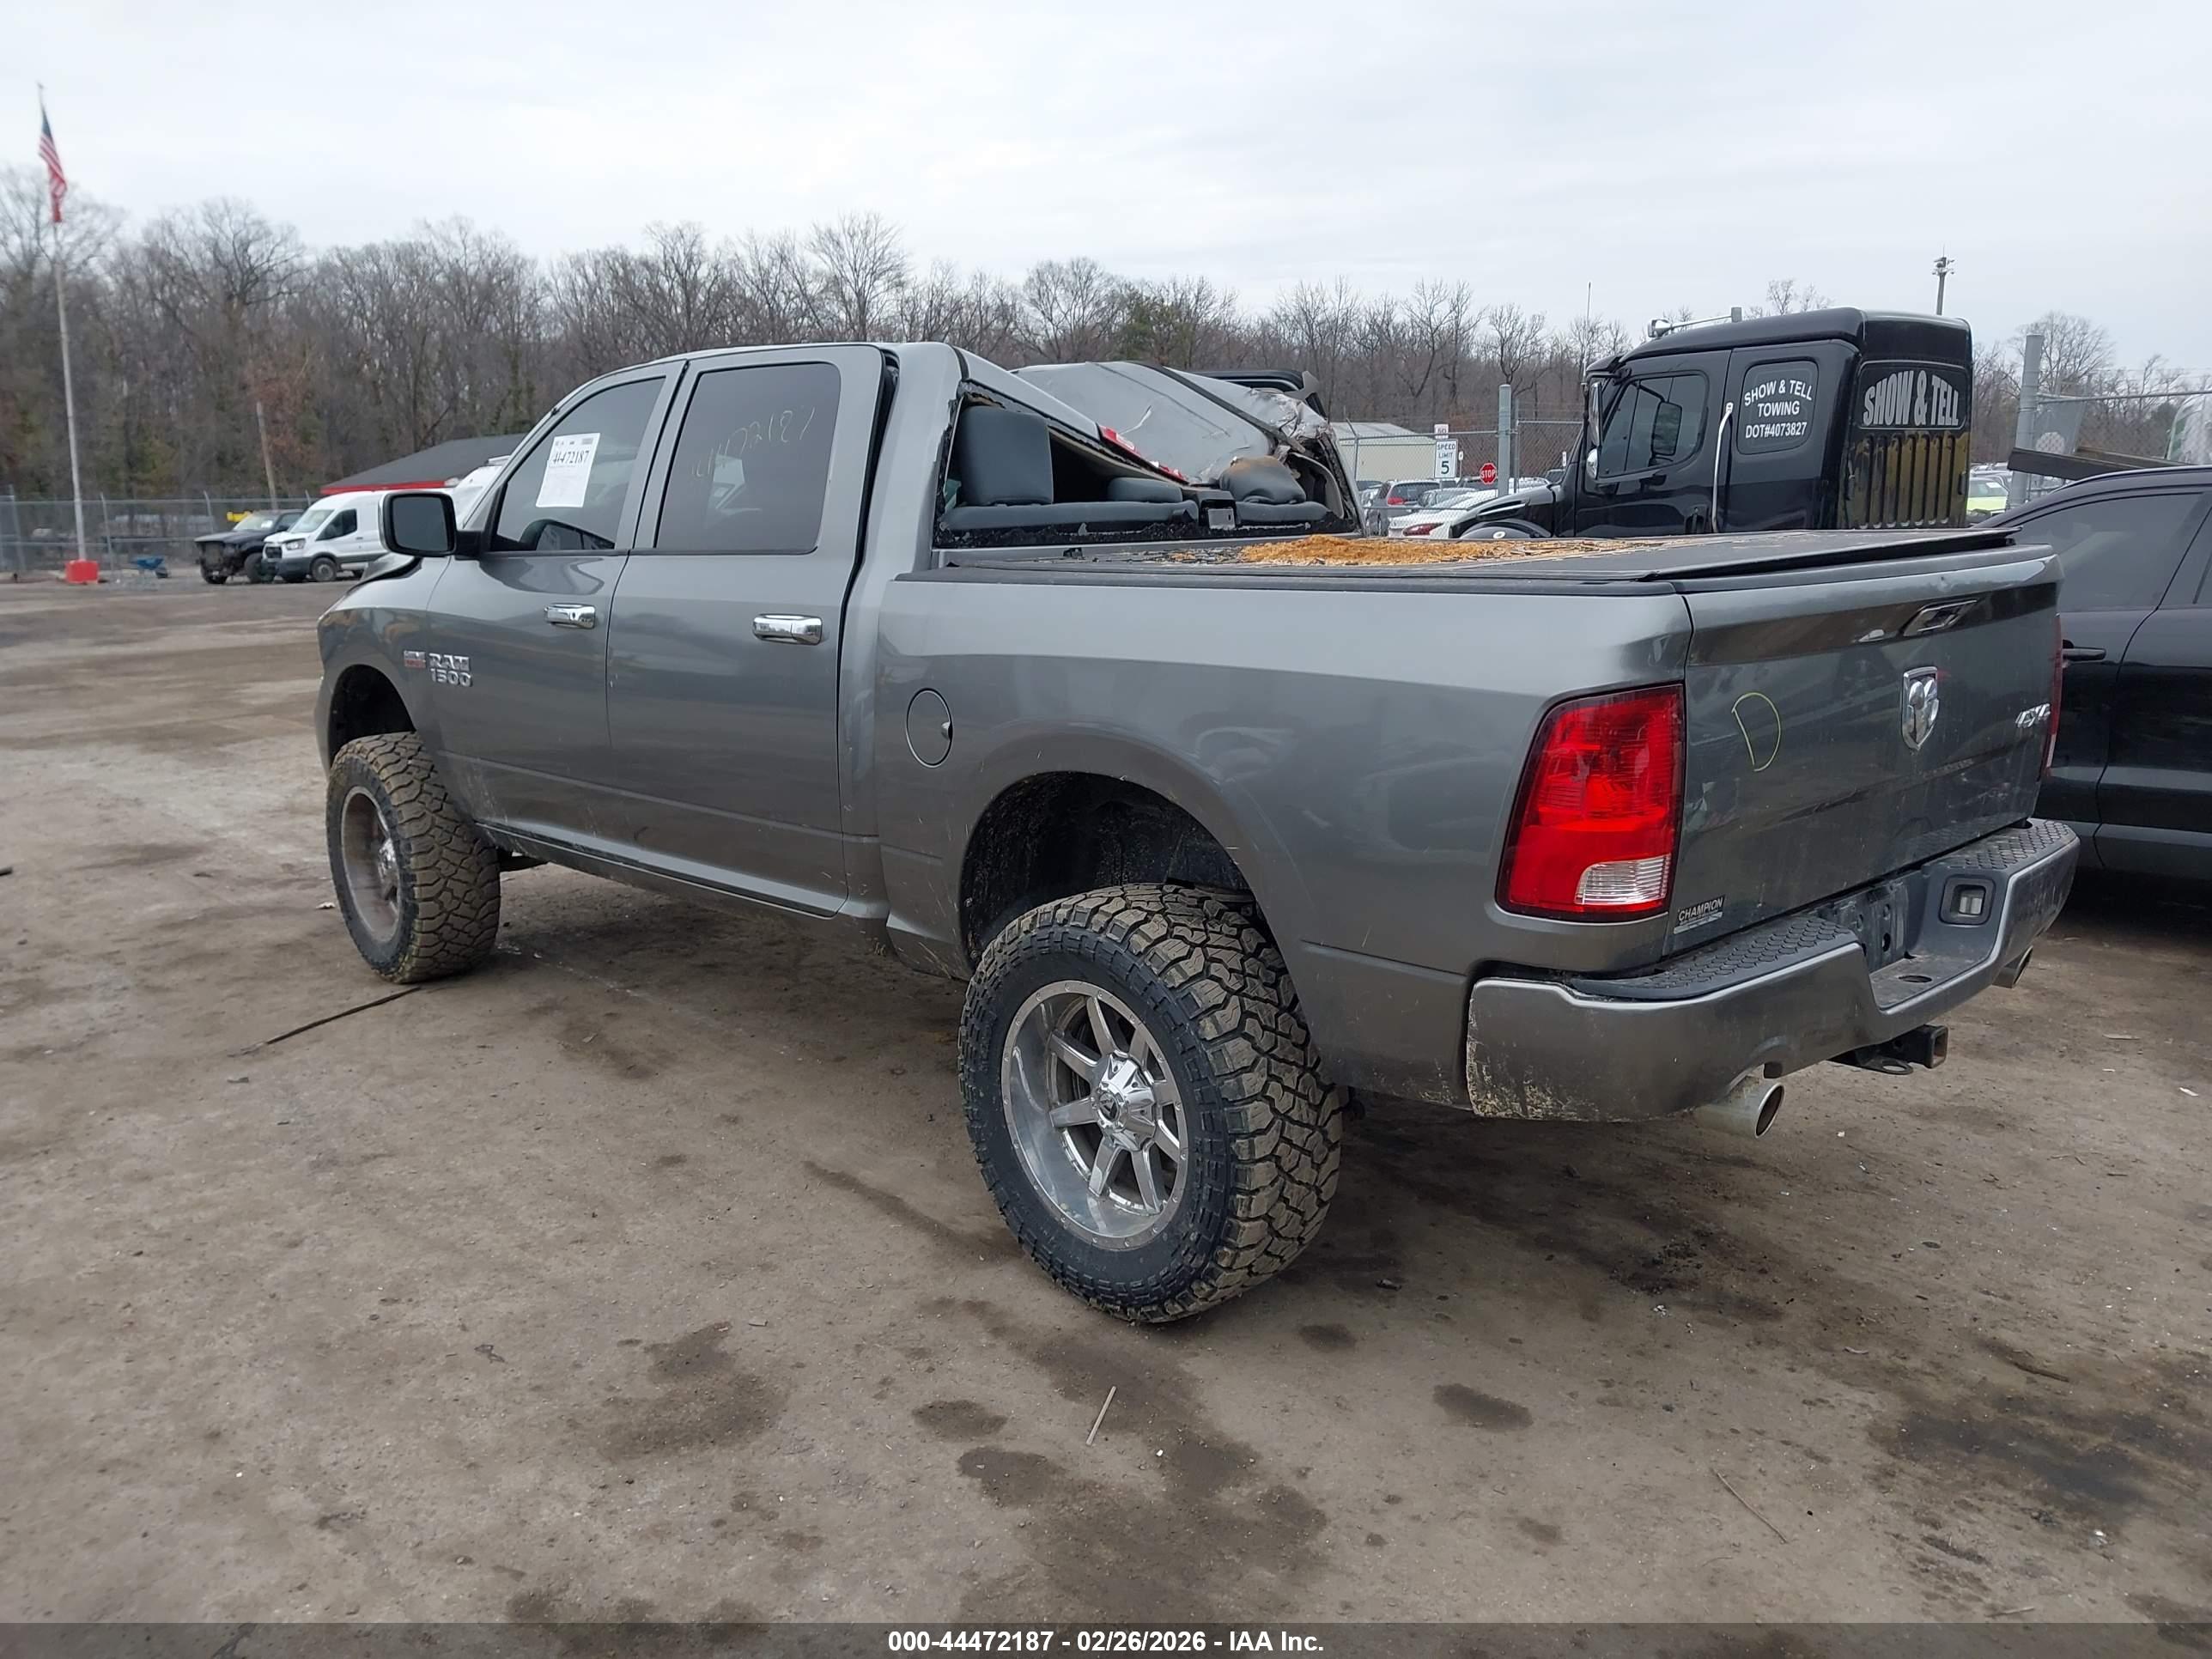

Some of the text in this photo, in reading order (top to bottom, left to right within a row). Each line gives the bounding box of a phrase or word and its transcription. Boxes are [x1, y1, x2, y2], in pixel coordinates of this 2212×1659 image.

[1744, 380, 1814, 406] SHOW & TELL
[1863, 369, 1960, 427] SHOW & TELL
[1757, 400, 1801, 417] TOWING
[1745, 422, 1808, 439] DOT#4073827
[1441, 460, 1449, 474] 5
[1480, 469, 1496, 478] STOP
[428, 653, 470, 672] RAM
[430, 668, 472, 686] 1500
[1678, 896, 1723, 921] CHAMPION
